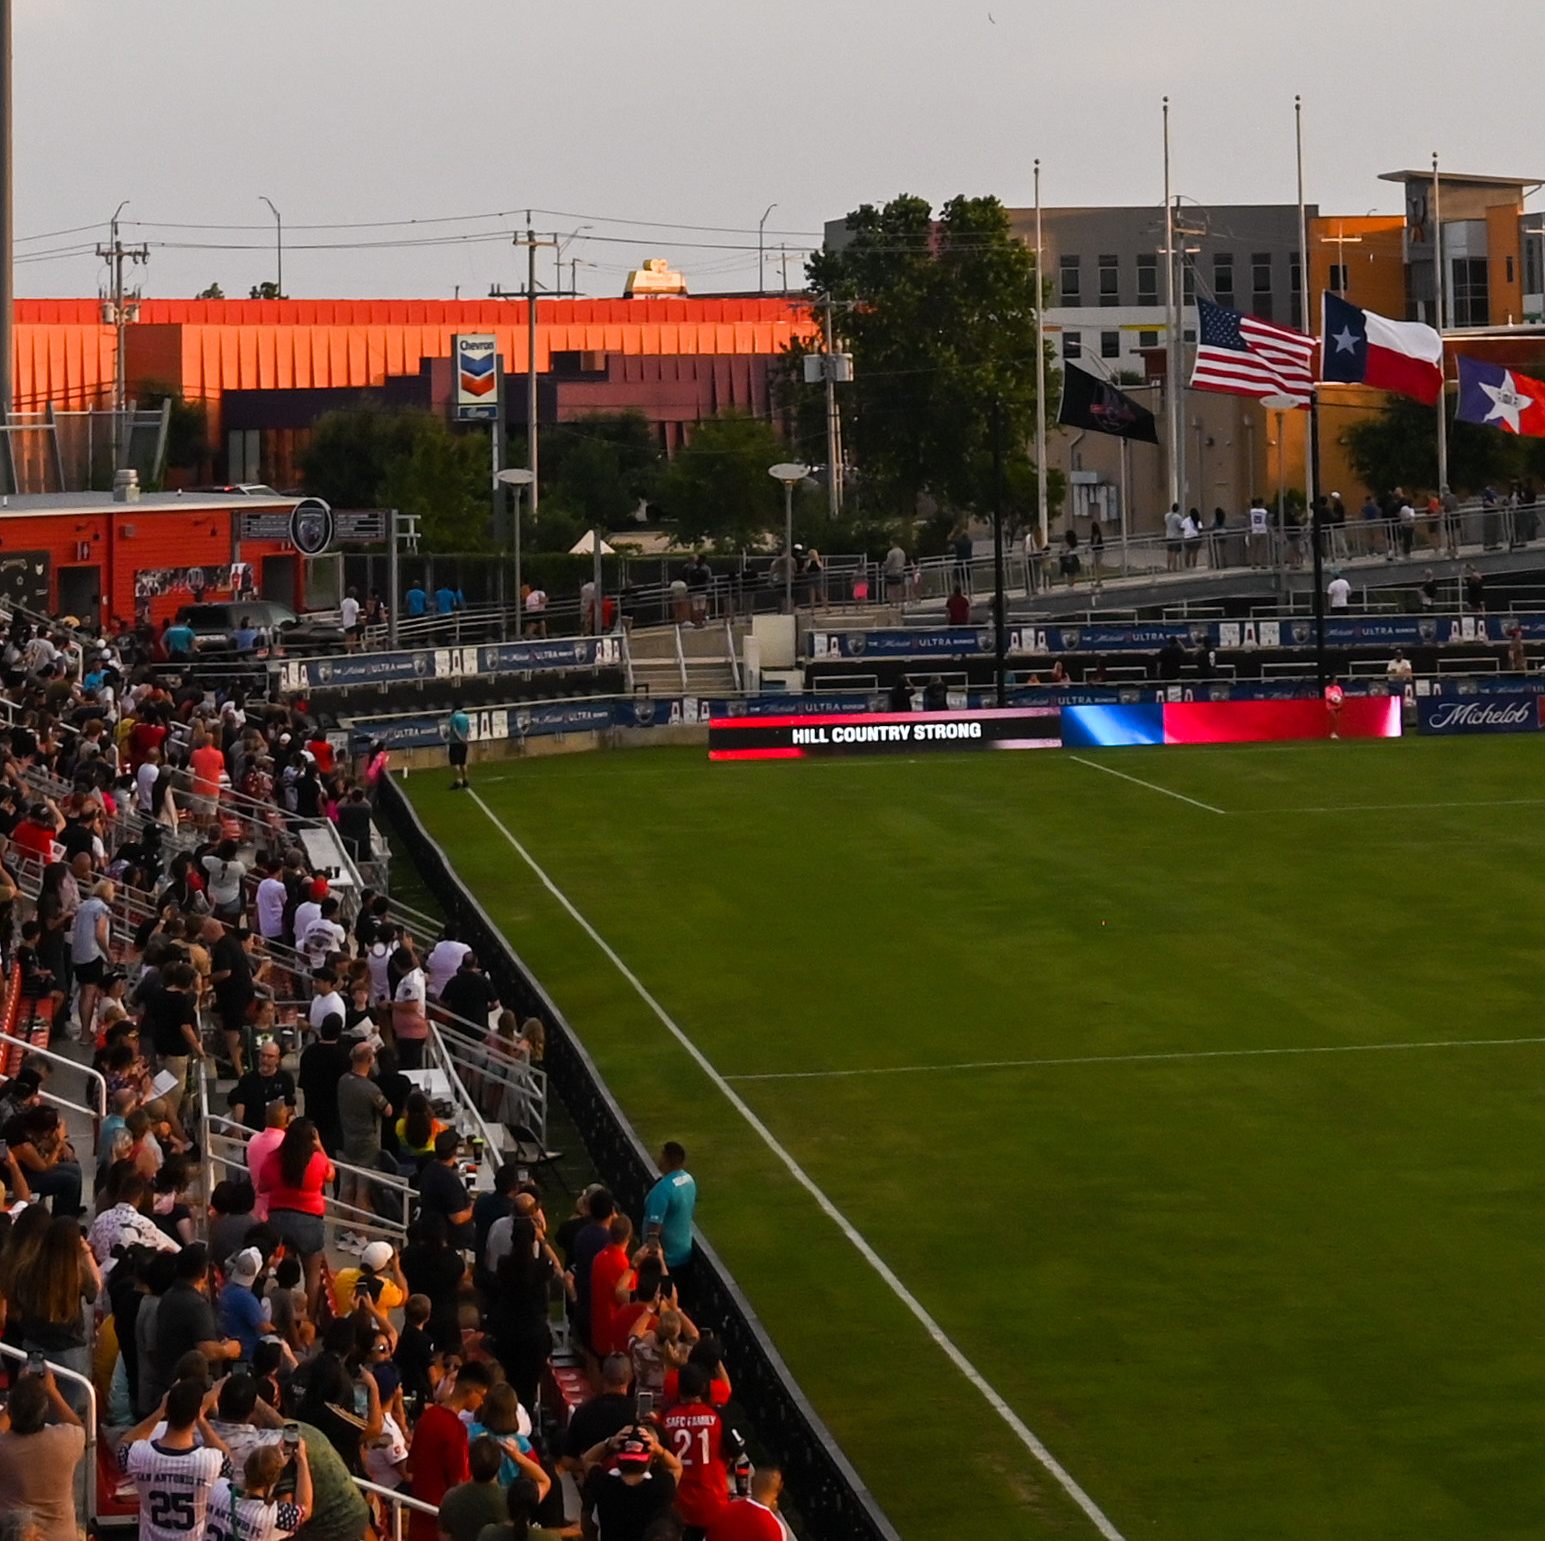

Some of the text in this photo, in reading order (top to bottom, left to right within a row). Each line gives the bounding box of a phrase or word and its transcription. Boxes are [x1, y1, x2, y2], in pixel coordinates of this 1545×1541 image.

[460, 340, 495, 351] Chevron
[919, 638, 952, 647] ULTRA
[1132, 632, 1164, 642] ULTRA
[806, 702, 841, 712] ULTRA
[1058, 696, 1093, 705] ULTRA
[1429, 702, 1531, 728] Michelob
[792, 722, 982, 744] HILL COUNTRY STRONG
[666, 1414, 716, 1428] SAFC FAMILY
[674, 1428, 710, 1466] 21
[154, 1473, 194, 1486] ANTONIO
[148, 1490, 196, 1531] 25
